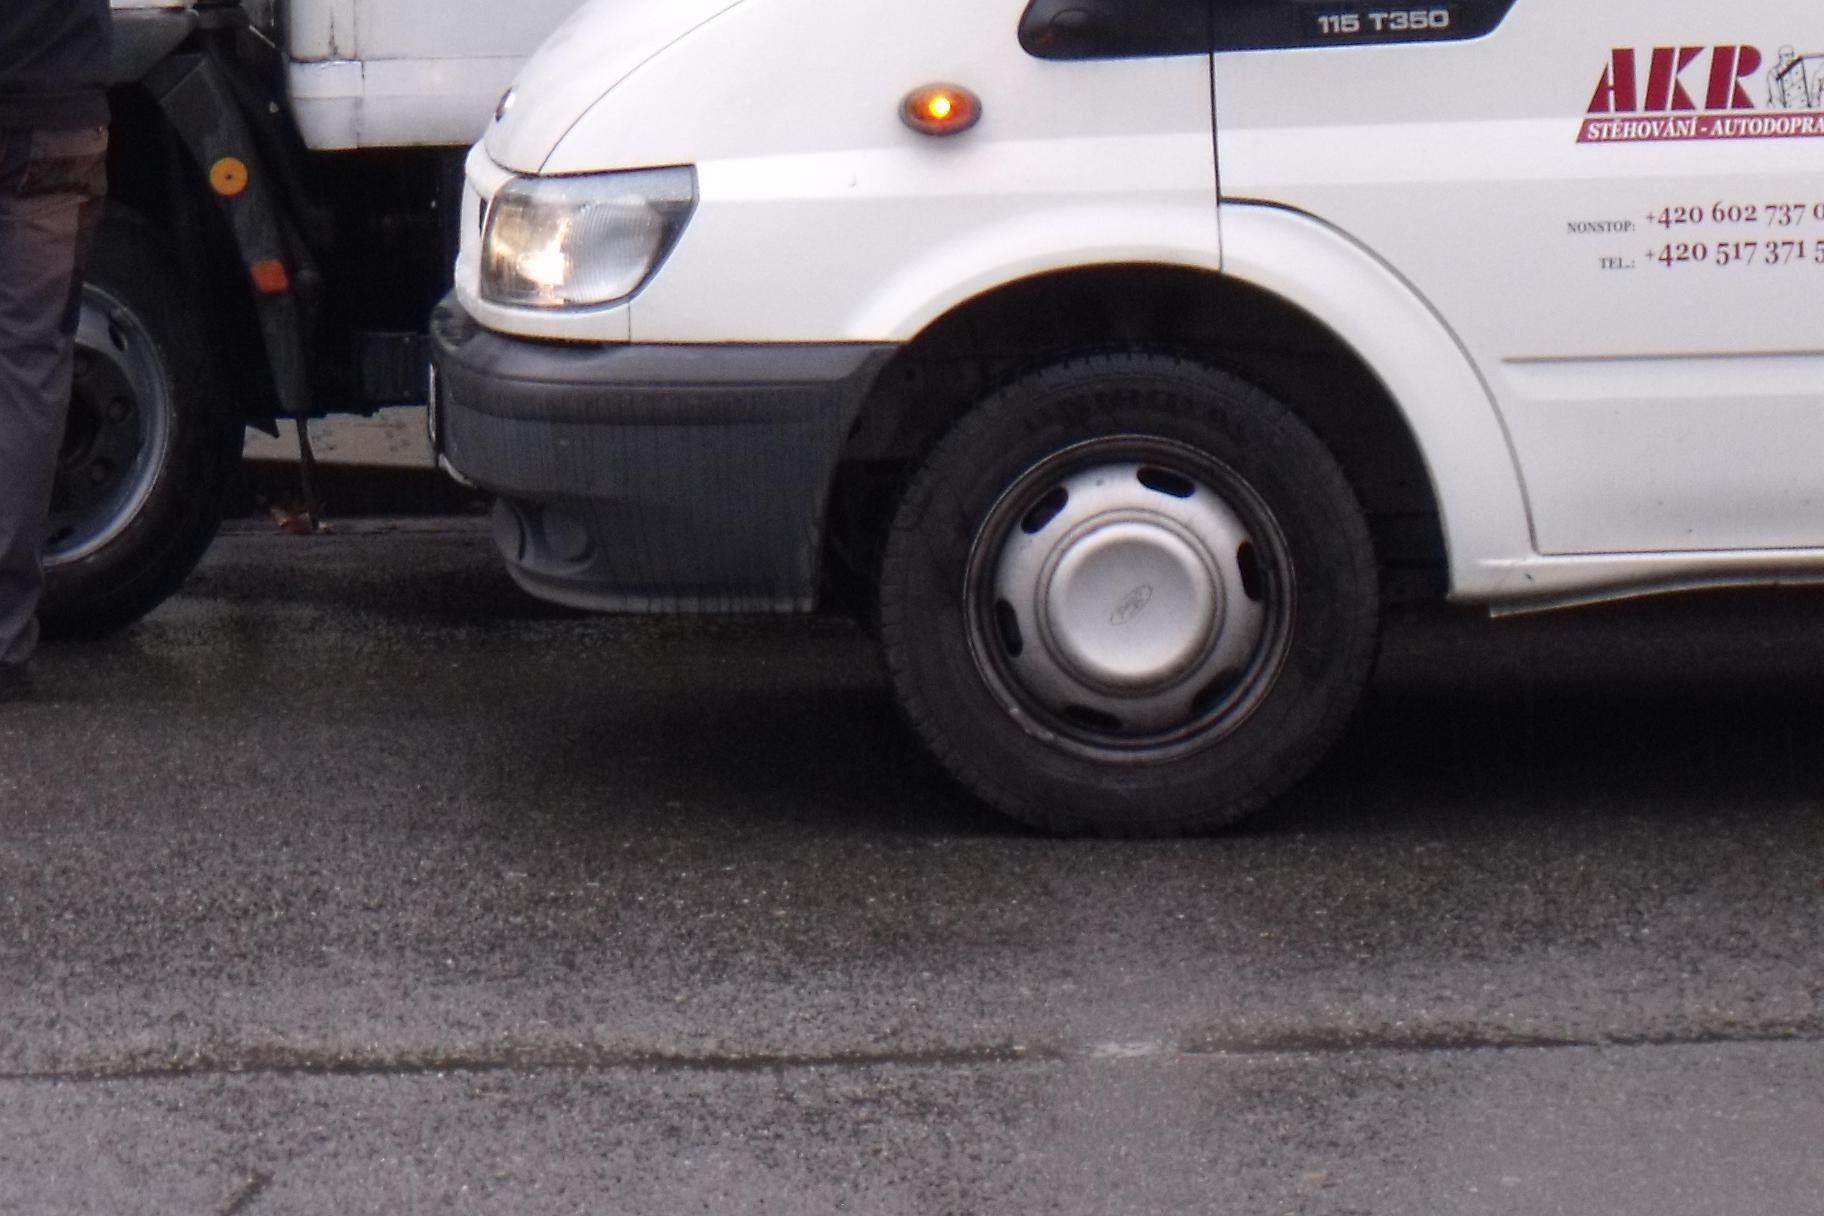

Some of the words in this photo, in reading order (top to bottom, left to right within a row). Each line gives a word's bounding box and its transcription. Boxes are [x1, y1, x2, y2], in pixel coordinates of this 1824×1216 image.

[1317, 13, 1360, 34] 115
[1368, 8, 1450, 31] T350
[1587, 45, 1762, 114] AKR
[1587, 116, 1697, 140] STĚHOVÁNÍ
[1567, 221, 1636, 233] NONSTOP:
[1646, 205, 1704, 229] +420
[1712, 200, 1758, 223] 602
[1765, 204, 1807, 226] 737
[1645, 241, 1708, 267] +420
[1716, 241, 1759, 266] 517
[1765, 239, 1807, 265] 371
